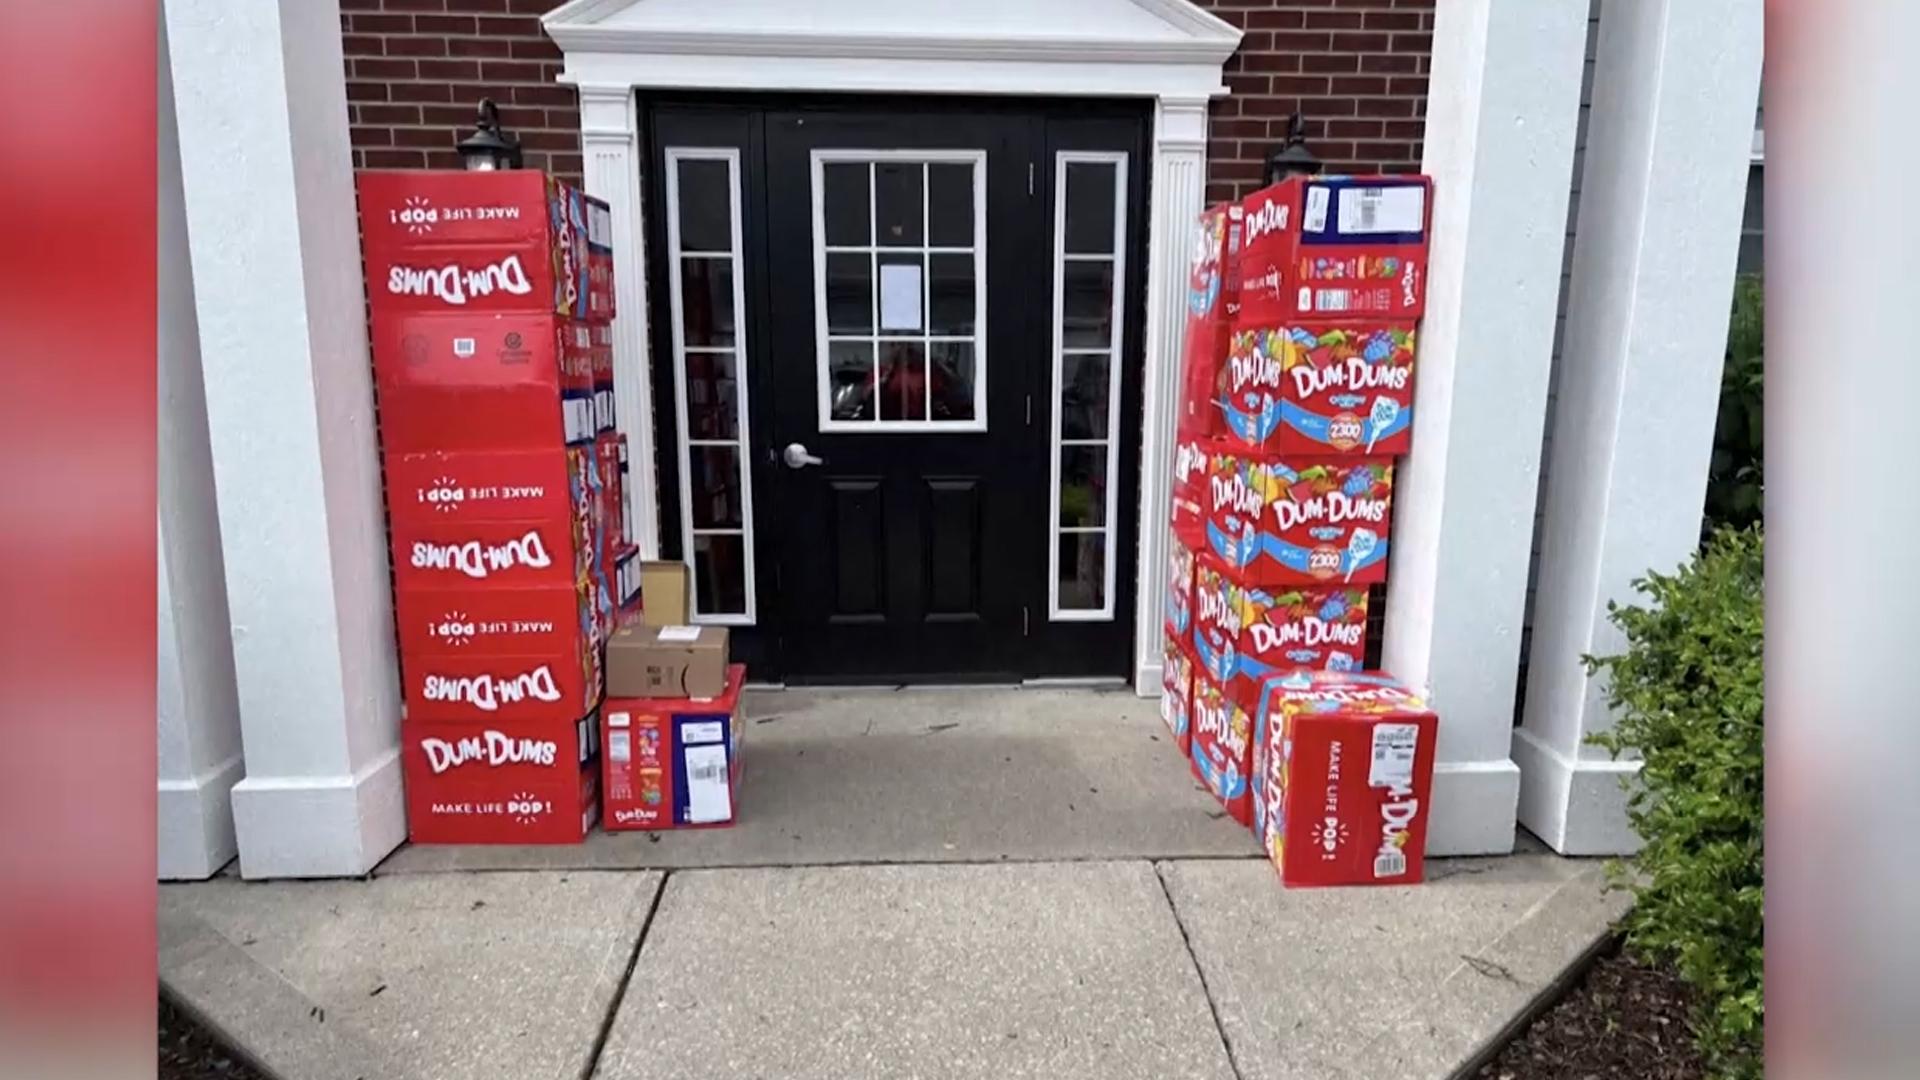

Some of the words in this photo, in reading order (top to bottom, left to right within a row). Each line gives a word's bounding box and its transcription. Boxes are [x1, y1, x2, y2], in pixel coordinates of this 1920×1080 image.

[443, 208, 472, 220] LIFE
[477, 207, 519, 219] MAKE
[1330, 423, 1361, 438] 2300
[470, 487, 498, 499] LIFE
[503, 486, 543, 498] MAKE
[1310, 554, 1340, 568] 2300
[479, 622, 508, 633] LIFE
[513, 622, 553, 633] MAKE
[1328, 740, 1342, 780] MAKE
[1325, 786, 1339, 812] LIFE
[432, 803, 472, 814] MAKE
[477, 803, 503, 814] LIFE
